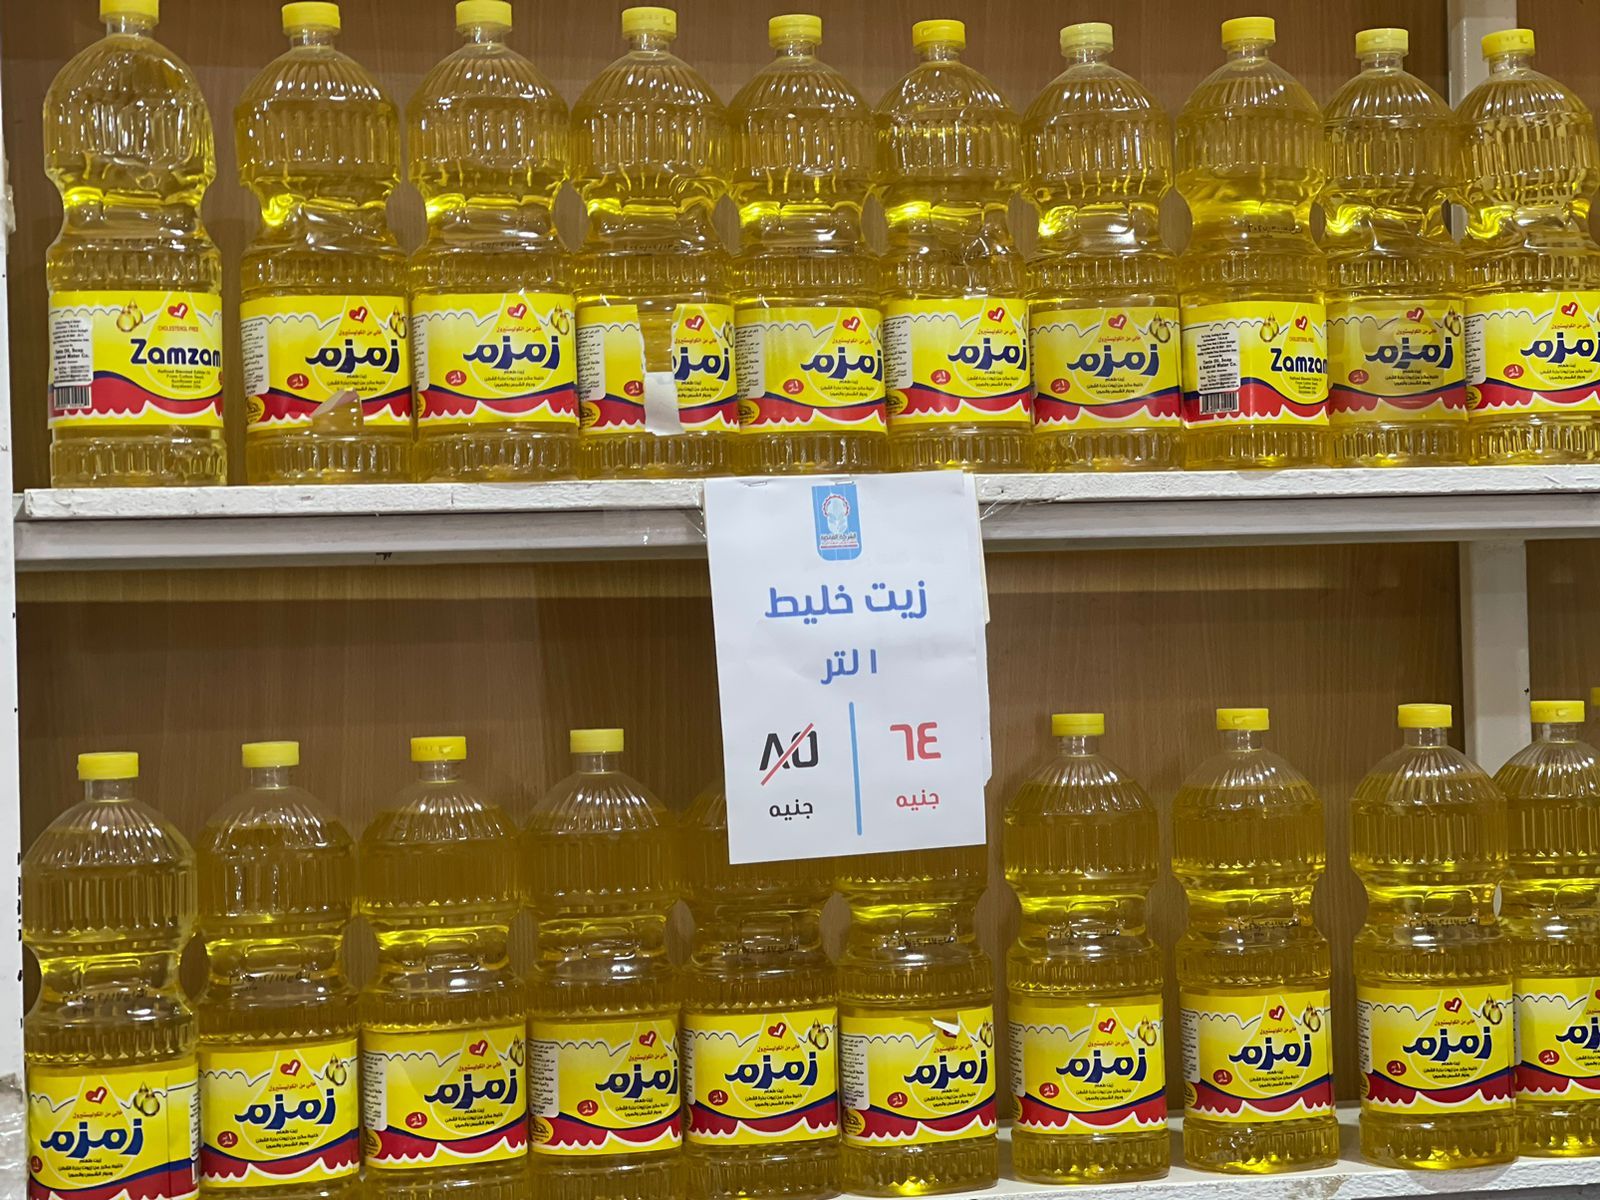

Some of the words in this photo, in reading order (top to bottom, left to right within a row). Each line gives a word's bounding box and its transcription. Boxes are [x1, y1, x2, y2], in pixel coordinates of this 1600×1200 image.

[305, 339, 400, 374] زمزم
[463, 336, 560, 370] زمزم
[801, 347, 882, 382] زمزم
[948, 338, 1027, 371] زمزم
[1067, 344, 1159, 377] زمزم
[1365, 337, 1453, 369] زمزم
[764, 584, 853, 624] خليط
[865, 580, 928, 619] زيت
[769, 799, 814, 822] جنيه
[895, 789, 940, 811] جنيه
[1229, 1034, 1311, 1070] زمزم
[1403, 1027, 1492, 1062] زمزم
[595, 1060, 678, 1098] زمزم
[724, 1052, 818, 1089] زمزم
[904, 1050, 987, 1089] زمزم
[1056, 1048, 1146, 1083] زمزم
[424, 1069, 517, 1109] زمزم
[235, 1088, 336, 1130] زمزم
[40, 1119, 144, 1158] زمزم
